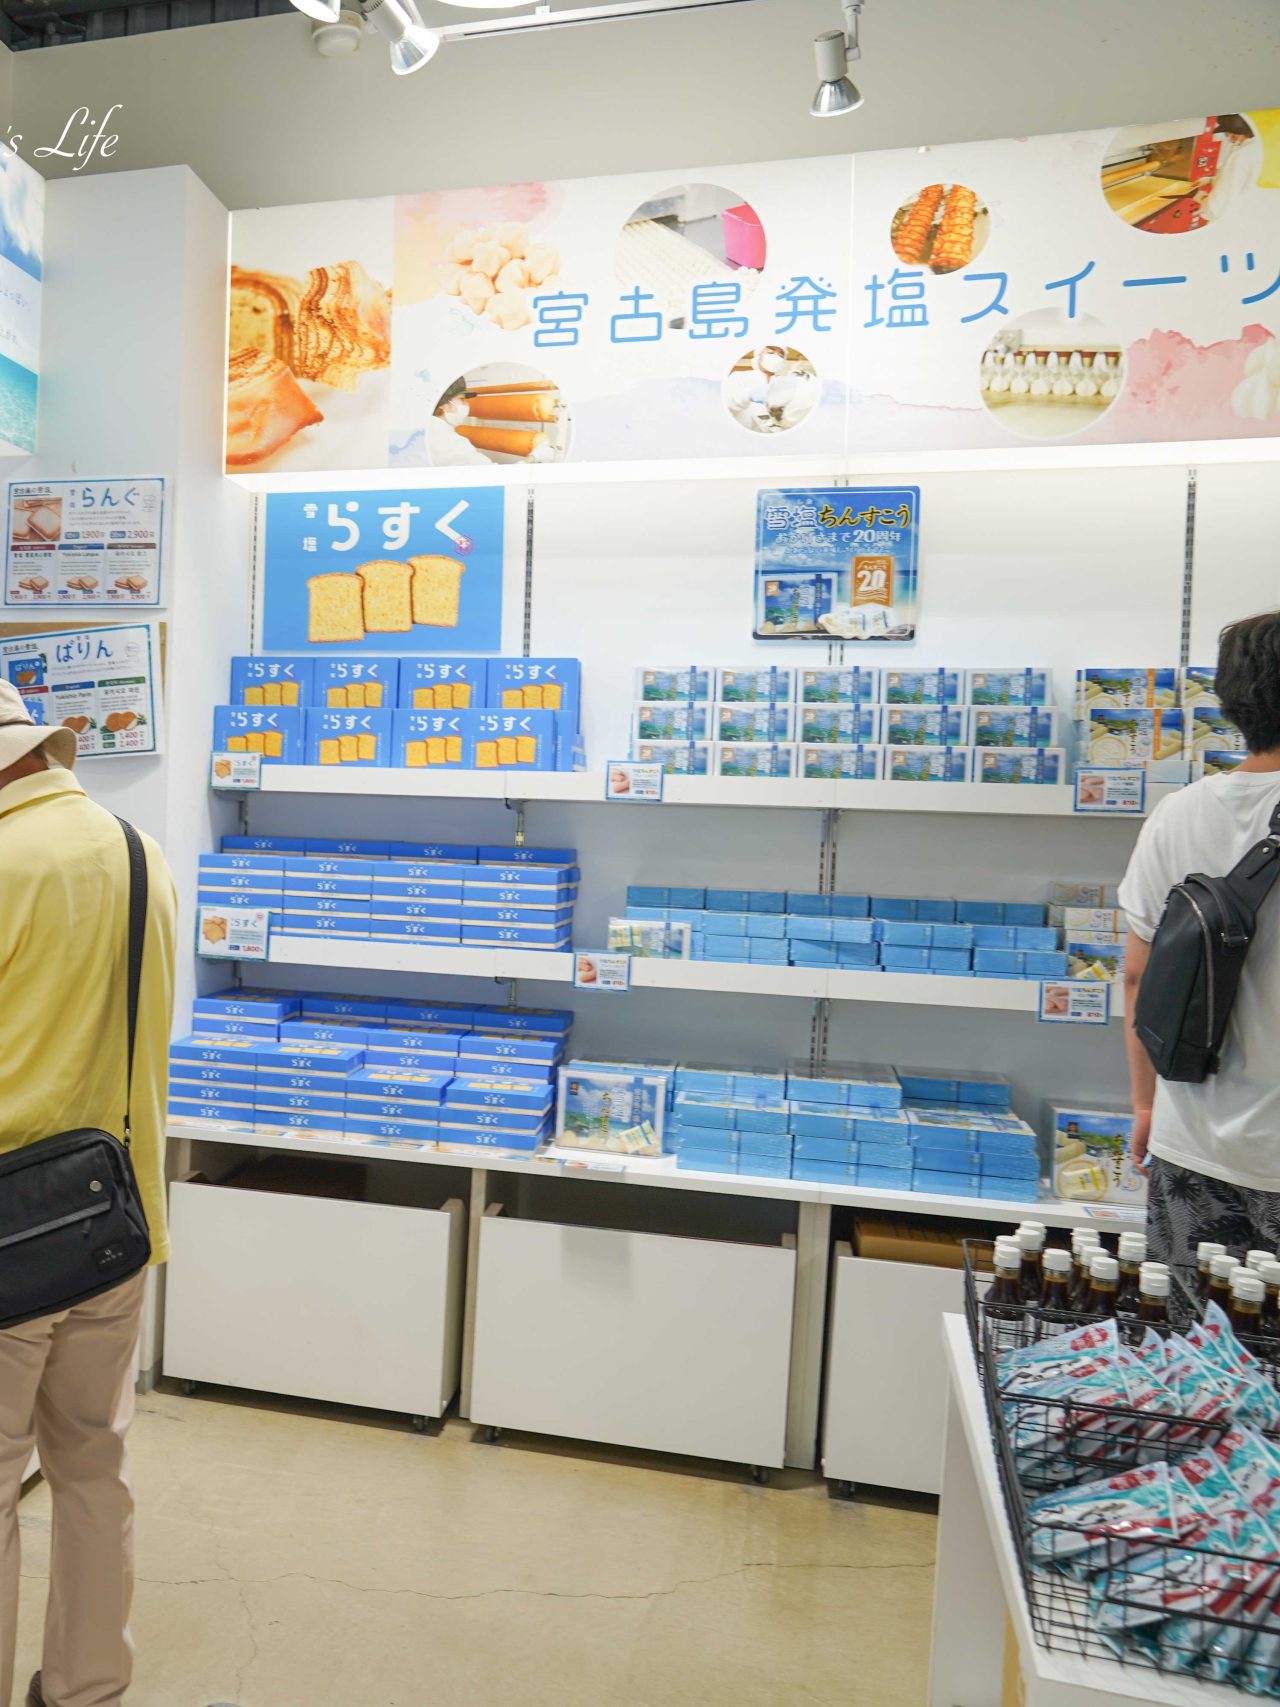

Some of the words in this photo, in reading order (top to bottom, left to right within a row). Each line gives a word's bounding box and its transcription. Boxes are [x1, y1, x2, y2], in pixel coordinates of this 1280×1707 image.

[532, 252, 1280, 349] 宮古島発塩スイーツ
[327, 500, 470, 551] らすく
[857, 570, 888, 592] 20
[255, 663, 293, 677] らすく
[337, 664, 377, 678] らすく
[424, 664, 465, 678] らすく
[513, 664, 556, 679] らすく
[238, 712, 277, 727] らすく
[331, 715, 371, 729] らすく
[417, 716, 459, 731] らすく
[487, 716, 530, 731] らすく
